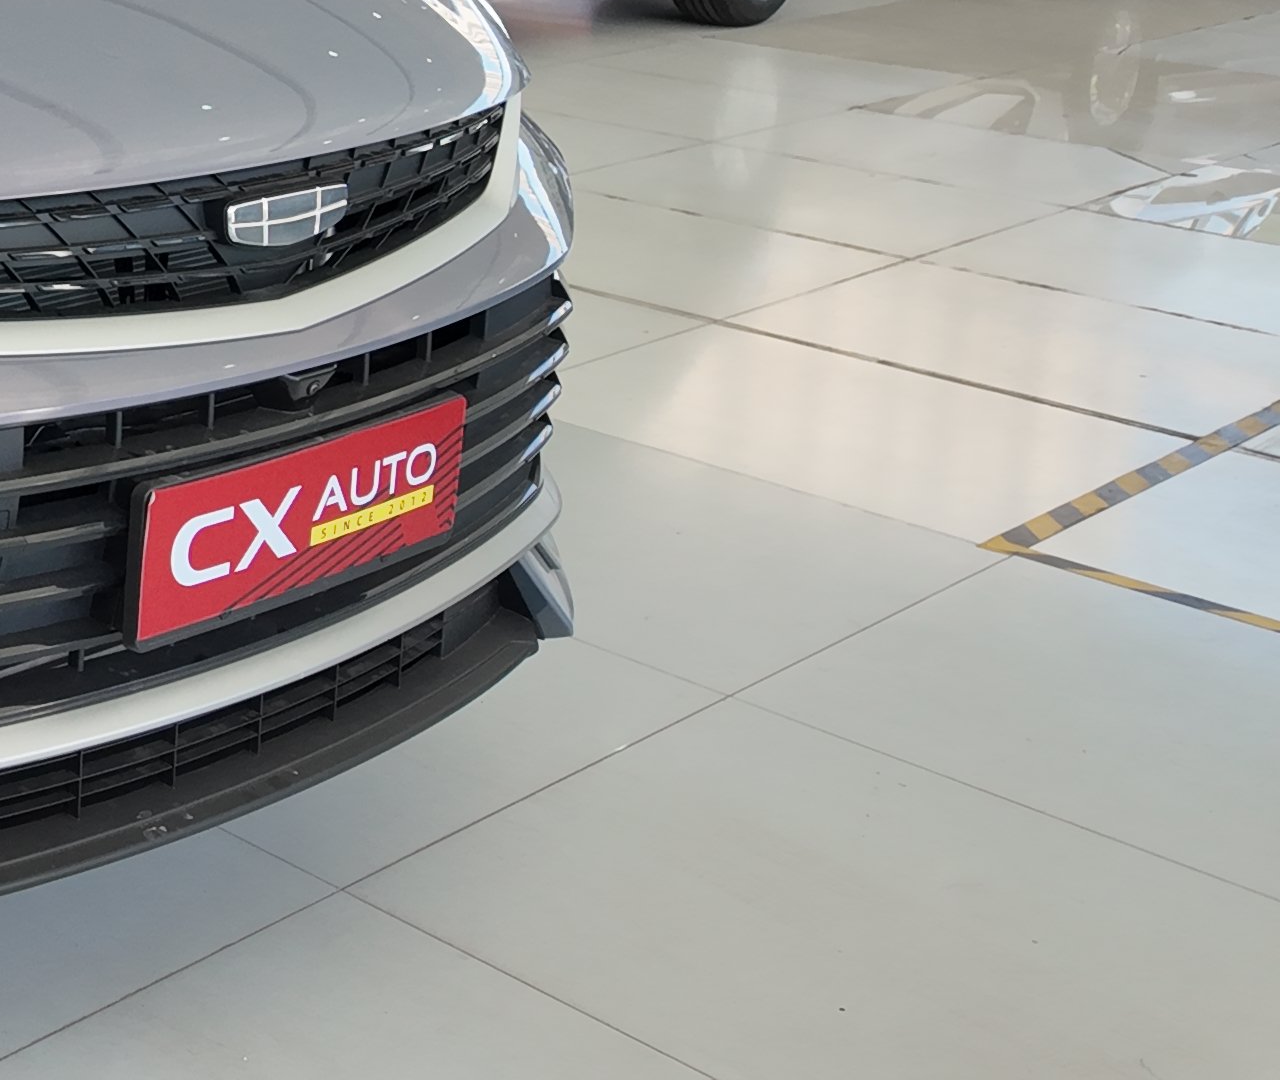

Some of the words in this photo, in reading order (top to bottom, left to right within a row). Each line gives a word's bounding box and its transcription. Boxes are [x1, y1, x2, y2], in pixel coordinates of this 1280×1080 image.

[170, 485, 302, 586] CX
[312, 443, 437, 521] AUTO
[321, 512, 373, 539] SINCE
[388, 491, 427, 514] 2012
